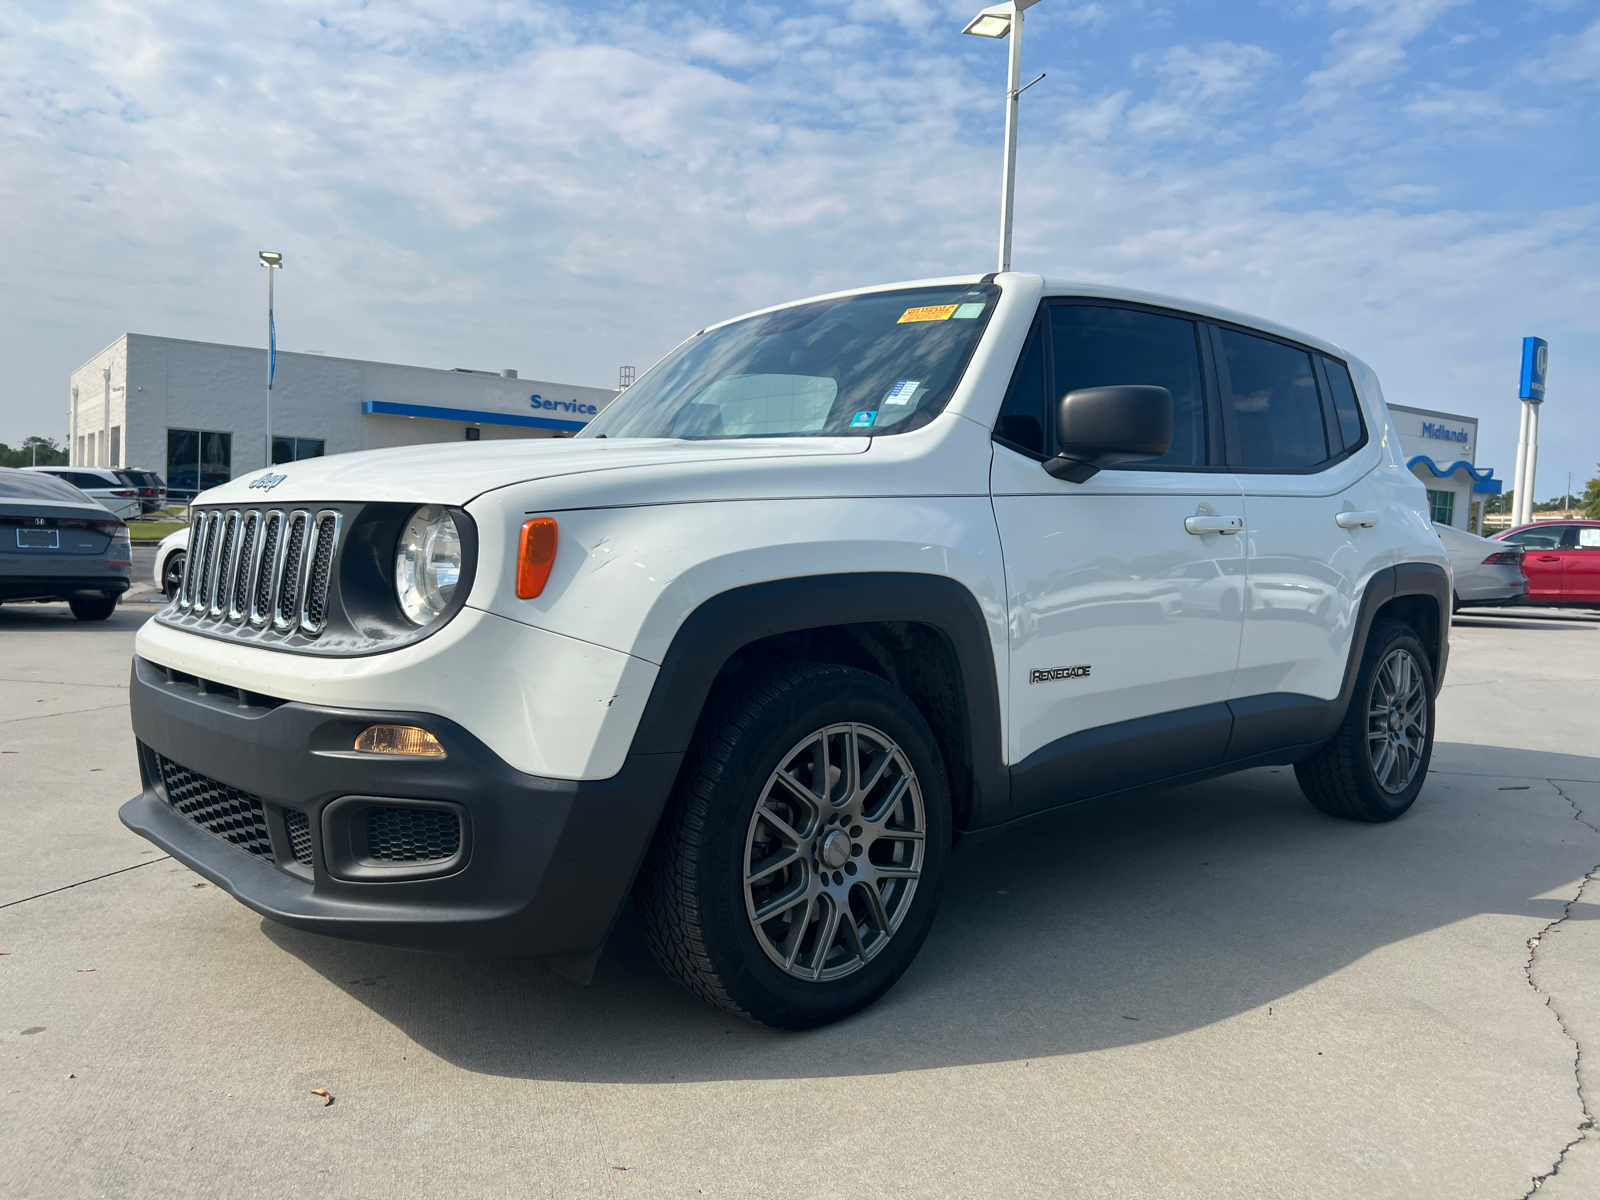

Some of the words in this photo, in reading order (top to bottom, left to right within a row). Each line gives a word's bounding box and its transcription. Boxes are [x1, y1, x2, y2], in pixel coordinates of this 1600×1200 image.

[531, 394, 597, 415] Service
[1422, 421, 1468, 443] Midlands
[1030, 665, 1091, 683] RENEGADE
